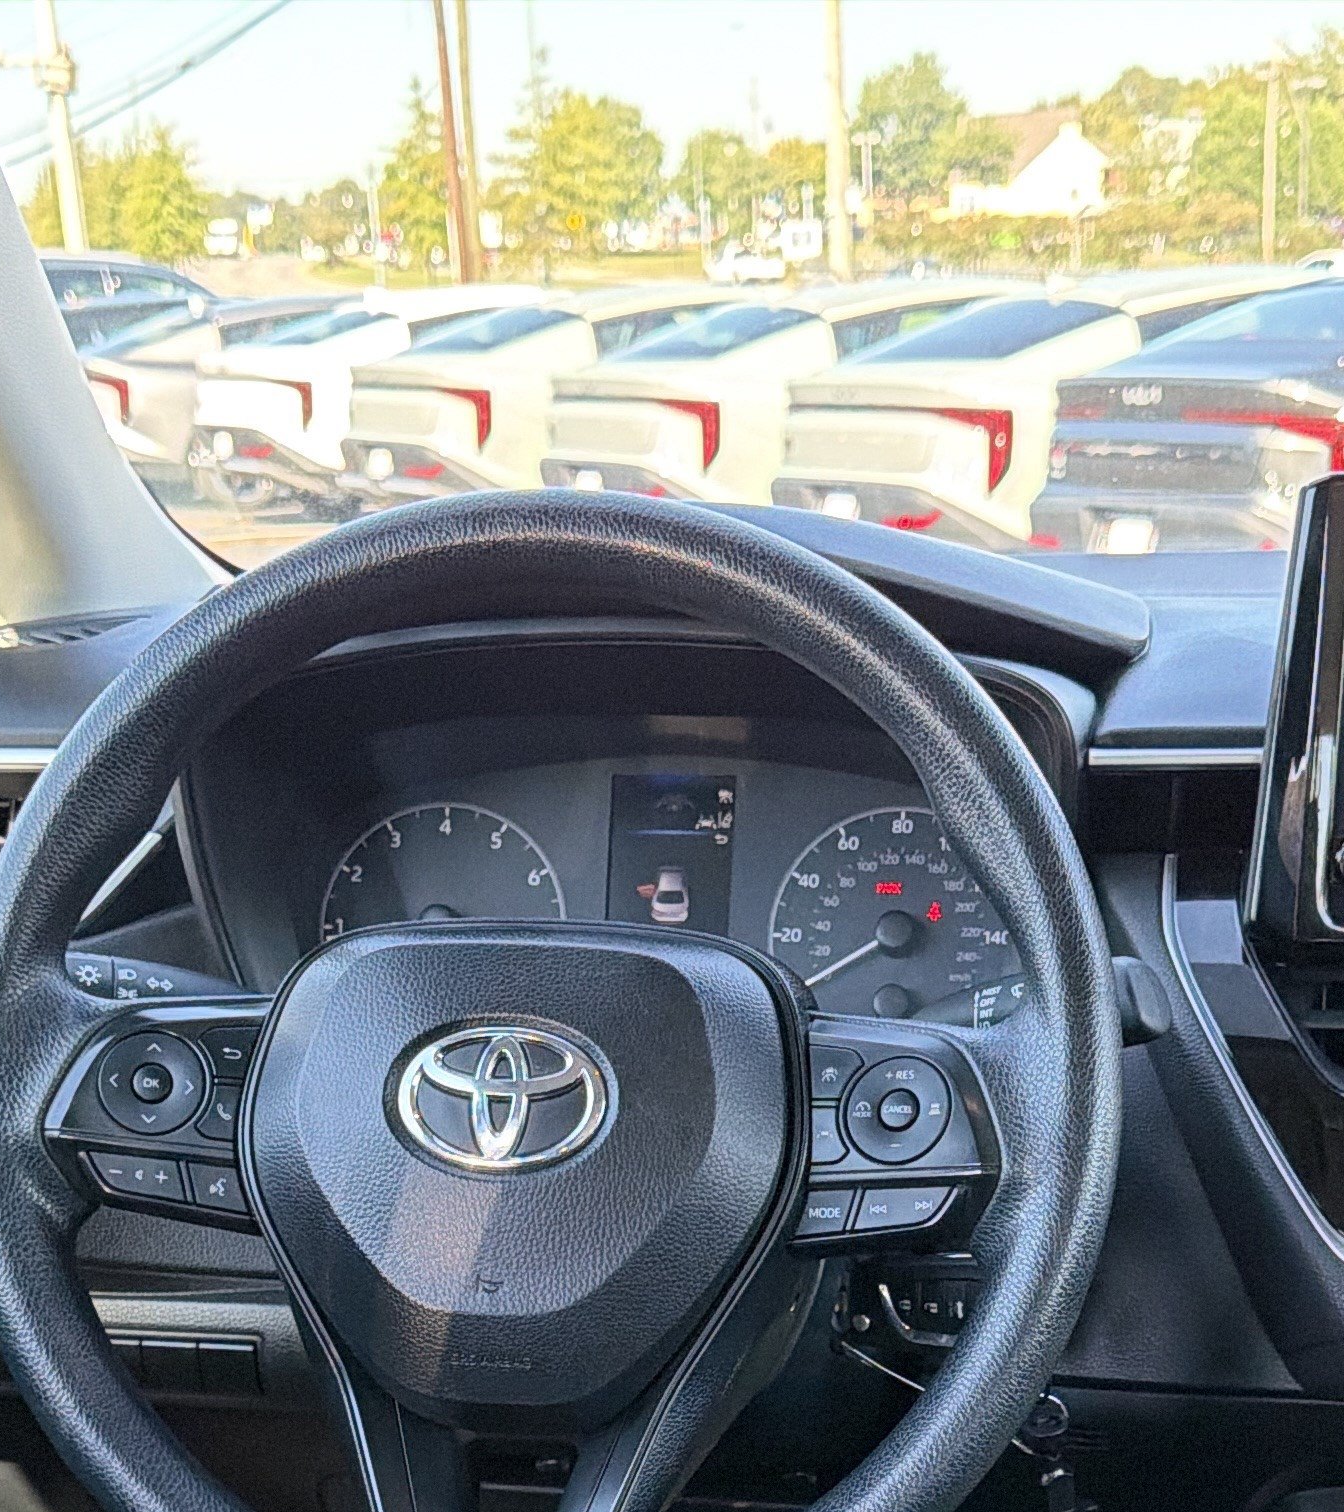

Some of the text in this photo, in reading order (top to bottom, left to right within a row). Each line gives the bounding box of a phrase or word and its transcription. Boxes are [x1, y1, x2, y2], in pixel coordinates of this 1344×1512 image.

[439, 819, 451, 835] 4
[891, 819, 914, 834] 80
[390, 831, 401, 848] 3
[490, 832, 502, 850] 5
[837, 836, 860, 851] 60
[878, 854, 900, 865] 120
[904, 854, 925, 865] 140
[857, 861, 878, 872] 100
[927, 863, 948, 874] 160
[350, 865, 362, 882] 2
[527, 869, 541, 886] 6
[797, 873, 820, 888] 40
[839, 877, 855, 888] 80
[943, 880, 964, 891] 180
[823, 896, 840, 907] 60
[955, 902, 975, 913] 200
[335, 918, 344, 934] 1
[814, 920, 831, 931] 40
[780, 928, 802, 942] 20
[960, 927, 980, 938] 220
[814, 945, 831, 956] 20
[979, 997, 996, 1008] OFF
[979, 1008, 994, 1018] INT
[895, 1069, 915, 1080] RES
[142, 1077, 159, 1089] OK
[883, 1105, 913, 1114] CANCEL
[808, 1207, 841, 1219] MODE
